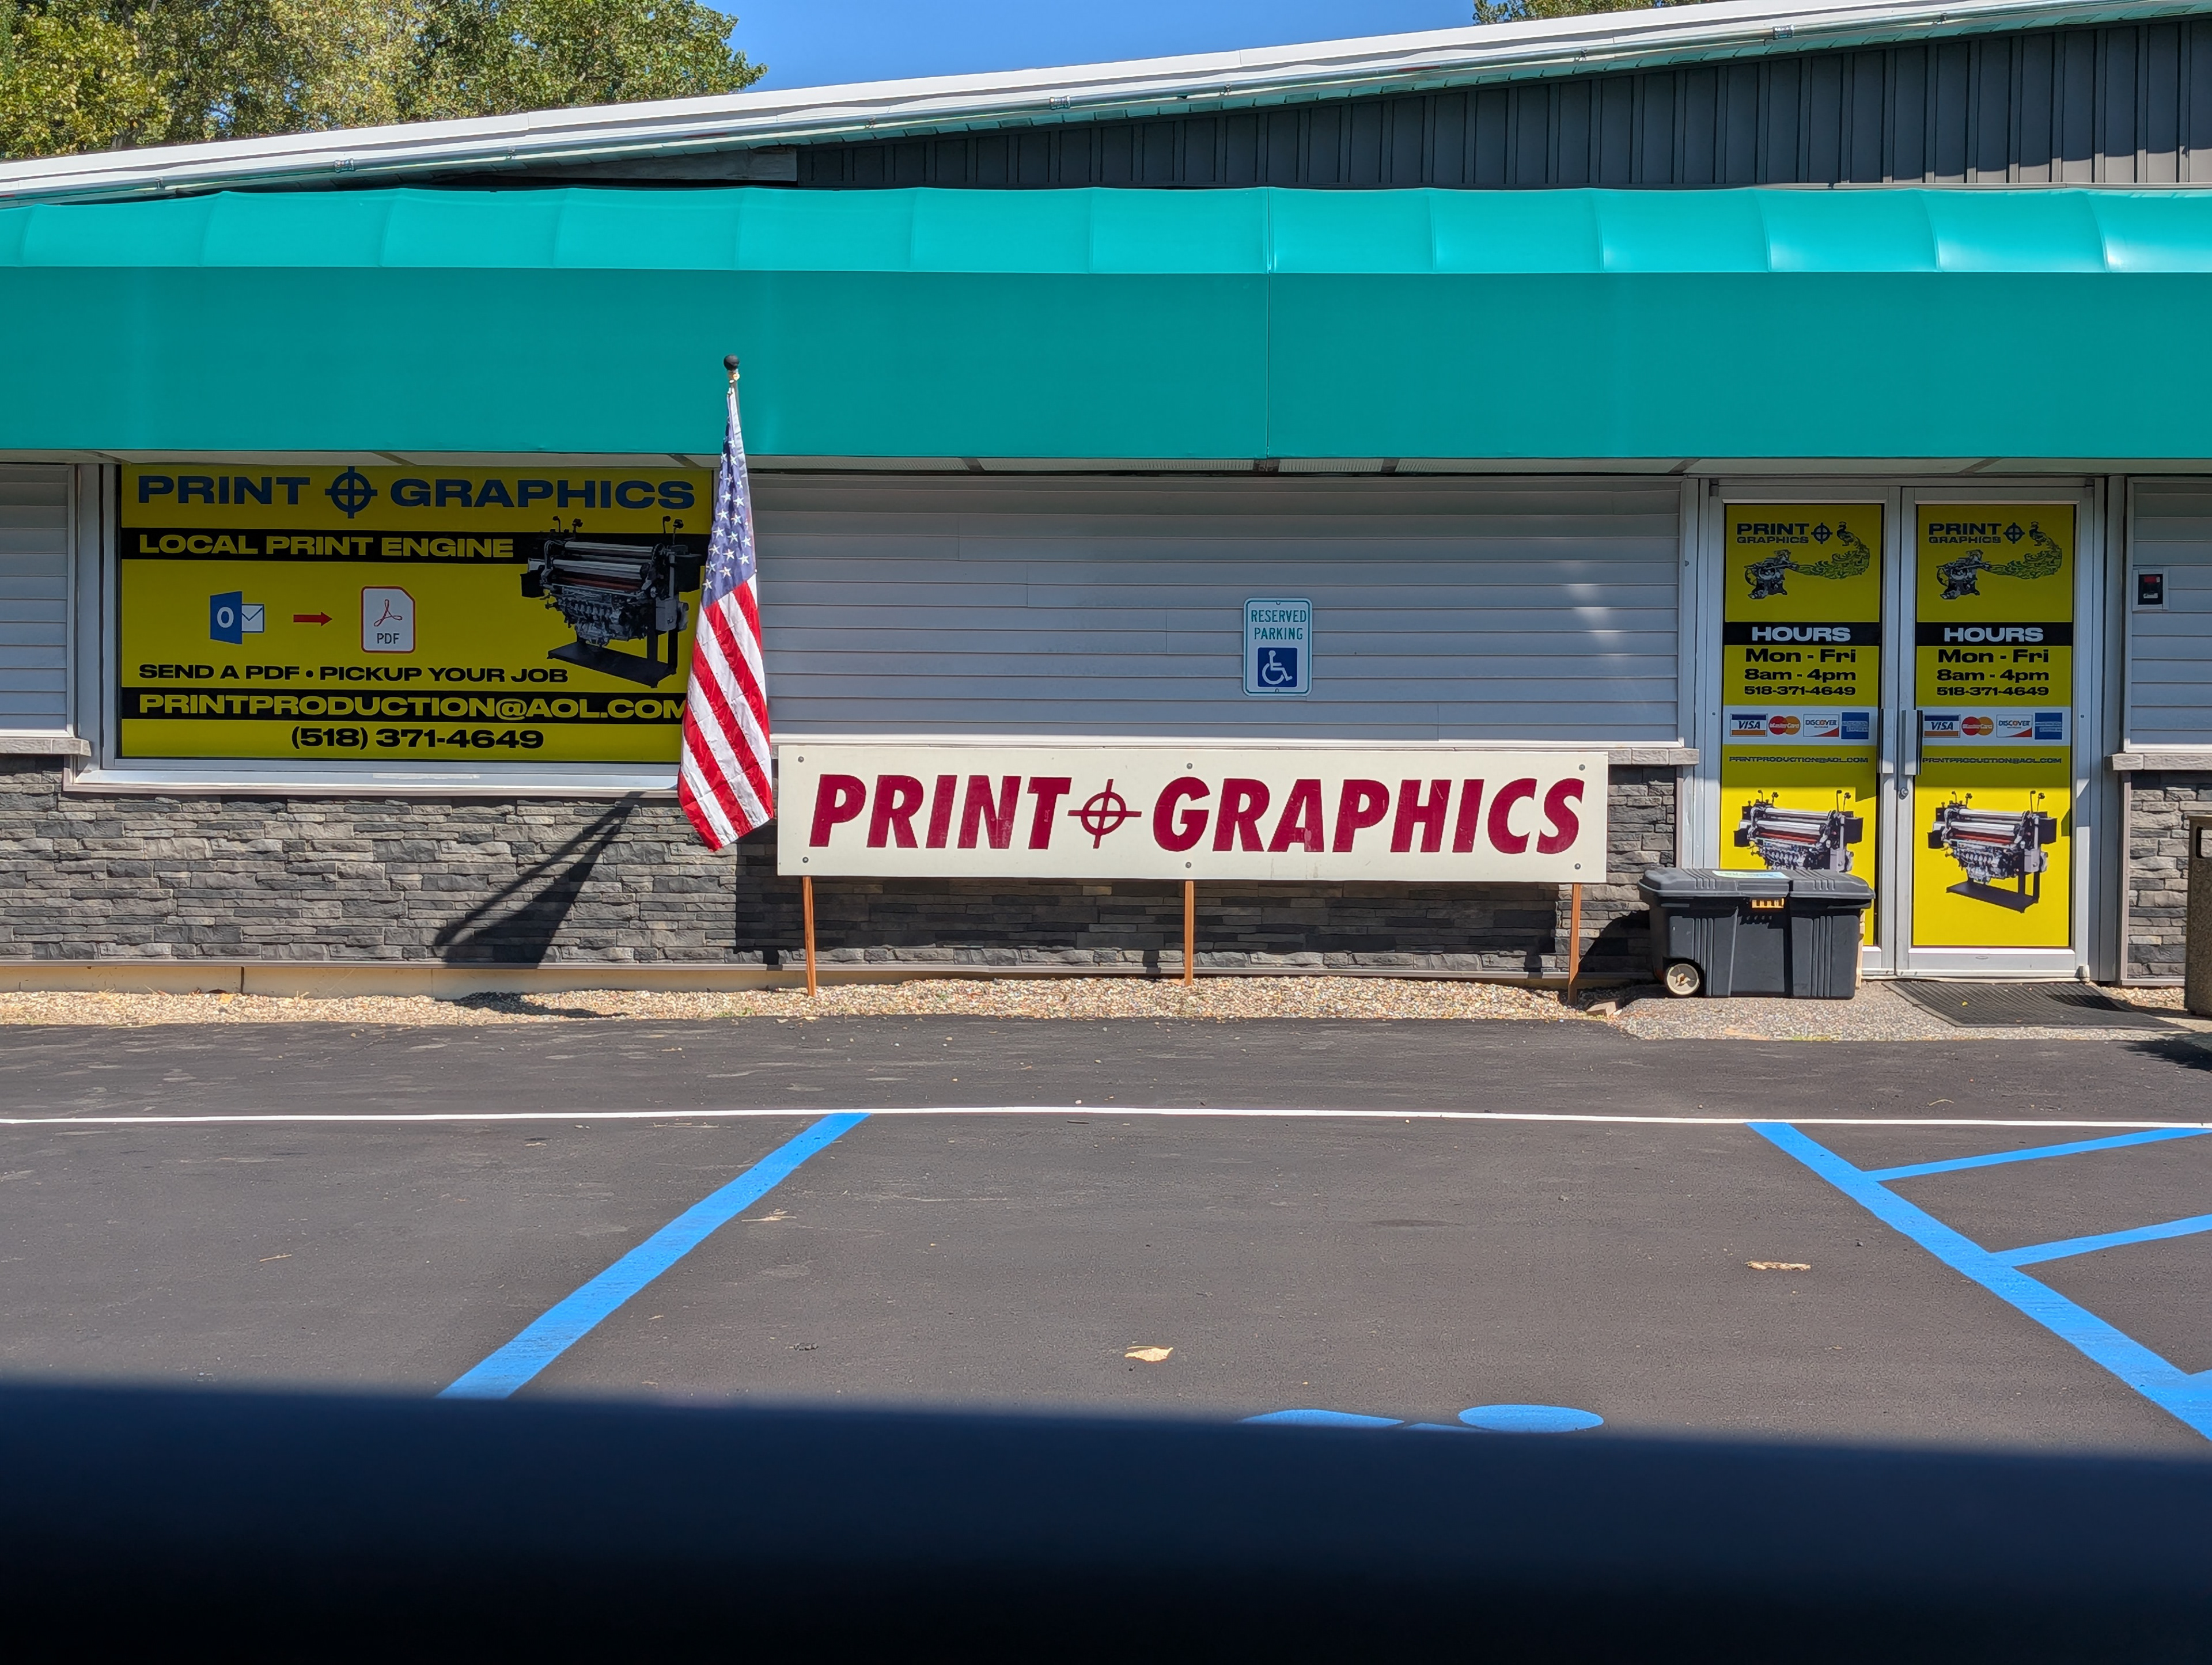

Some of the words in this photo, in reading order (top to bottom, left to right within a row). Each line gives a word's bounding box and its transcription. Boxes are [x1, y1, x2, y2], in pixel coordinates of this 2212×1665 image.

[138, 475, 310, 505] PRINT
[390, 479, 695, 509] GRAPHICS
[1736, 523, 1810, 536] PRINT
[1929, 523, 2002, 536] PRINT
[139, 534, 259, 555] LOCAL
[266, 536, 373, 556] PRINT
[381, 537, 514, 557] ENGINE
[1251, 610, 1306, 623] RESERVED
[376, 632, 400, 645] PDF
[1254, 627, 1303, 640] PARKING
[1752, 627, 1851, 642] HOURS
[1944, 627, 2044, 642] HOURS
[1745, 648, 1801, 662] Mon
[1820, 648, 1856, 663] Fri
[1938, 648, 1994, 663] Mon
[2013, 649, 2049, 663] Fri
[139, 665, 215, 680] SEND
[219, 665, 240, 680] A
[245, 666, 300, 680] PDF
[320, 667, 422, 681] PICKUP
[428, 667, 505, 682] YOUR
[510, 669, 569, 683] JOB
[1744, 669, 1792, 680] 8am
[1806, 669, 1856, 683] 4pm
[1937, 669, 1985, 681] 8am
[1999, 669, 2050, 683] 4pm
[1744, 686, 1856, 695] 518-371-4649
[1937, 687, 2049, 696] 518-371-4649
[139, 694, 687, 720] PRINTPRODUCTION@AOL.COM
[1738, 720, 1761, 729] VISA
[1931, 721, 1953, 730] VISA
[291, 726, 369, 750] (518)
[376, 728, 544, 749] 371-4649
[809, 773, 1073, 849] PRINT
[1152, 776, 1585, 855] GRAPHICS
